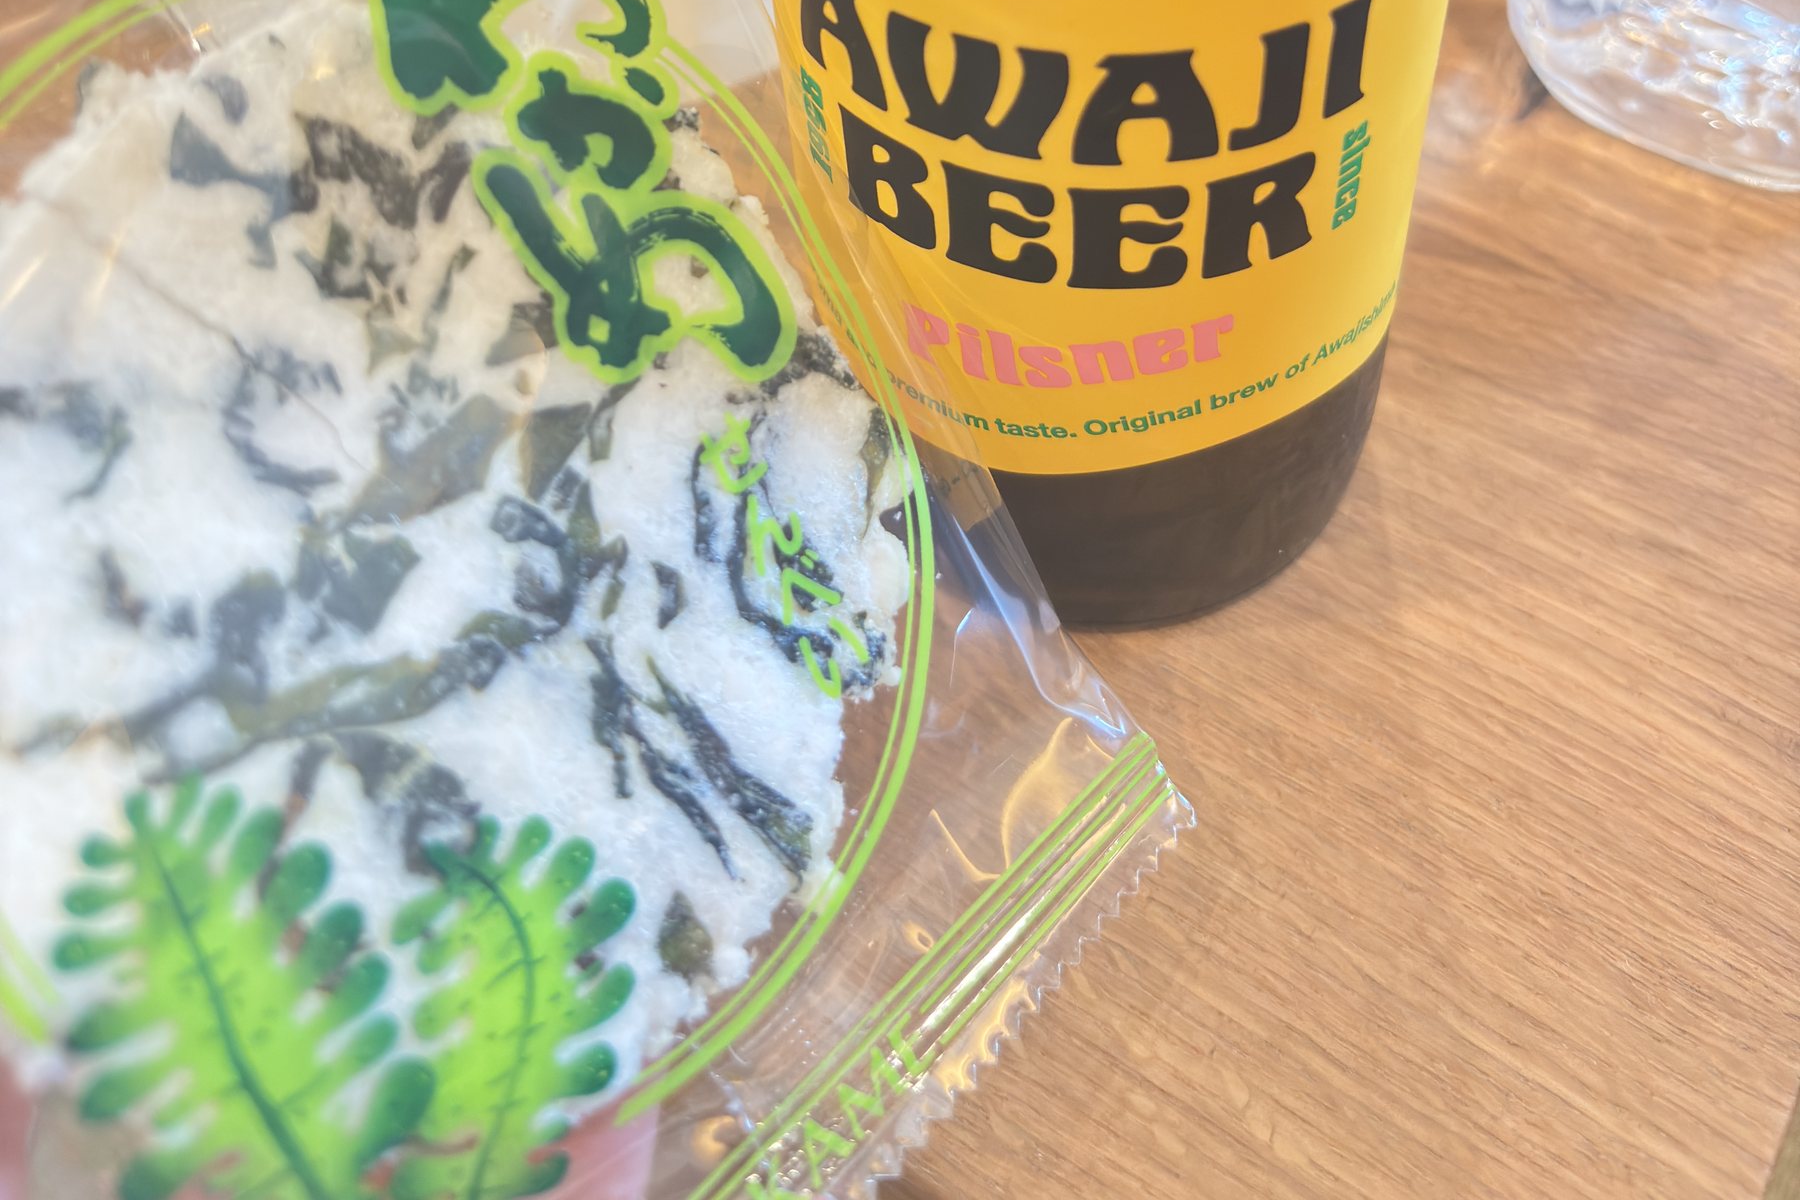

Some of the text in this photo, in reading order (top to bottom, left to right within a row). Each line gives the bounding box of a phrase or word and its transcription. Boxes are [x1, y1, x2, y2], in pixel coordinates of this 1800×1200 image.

[838, 102, 1316, 290] BEER
[1331, 119, 1371, 231] since
[902, 300, 1235, 388] Pilsner
[994, 417, 1078, 440] taste.
[1083, 397, 1203, 435] Original
[1209, 371, 1280, 411] brew
[1284, 352, 1311, 380] of
[699, 412, 871, 698] せんべい
